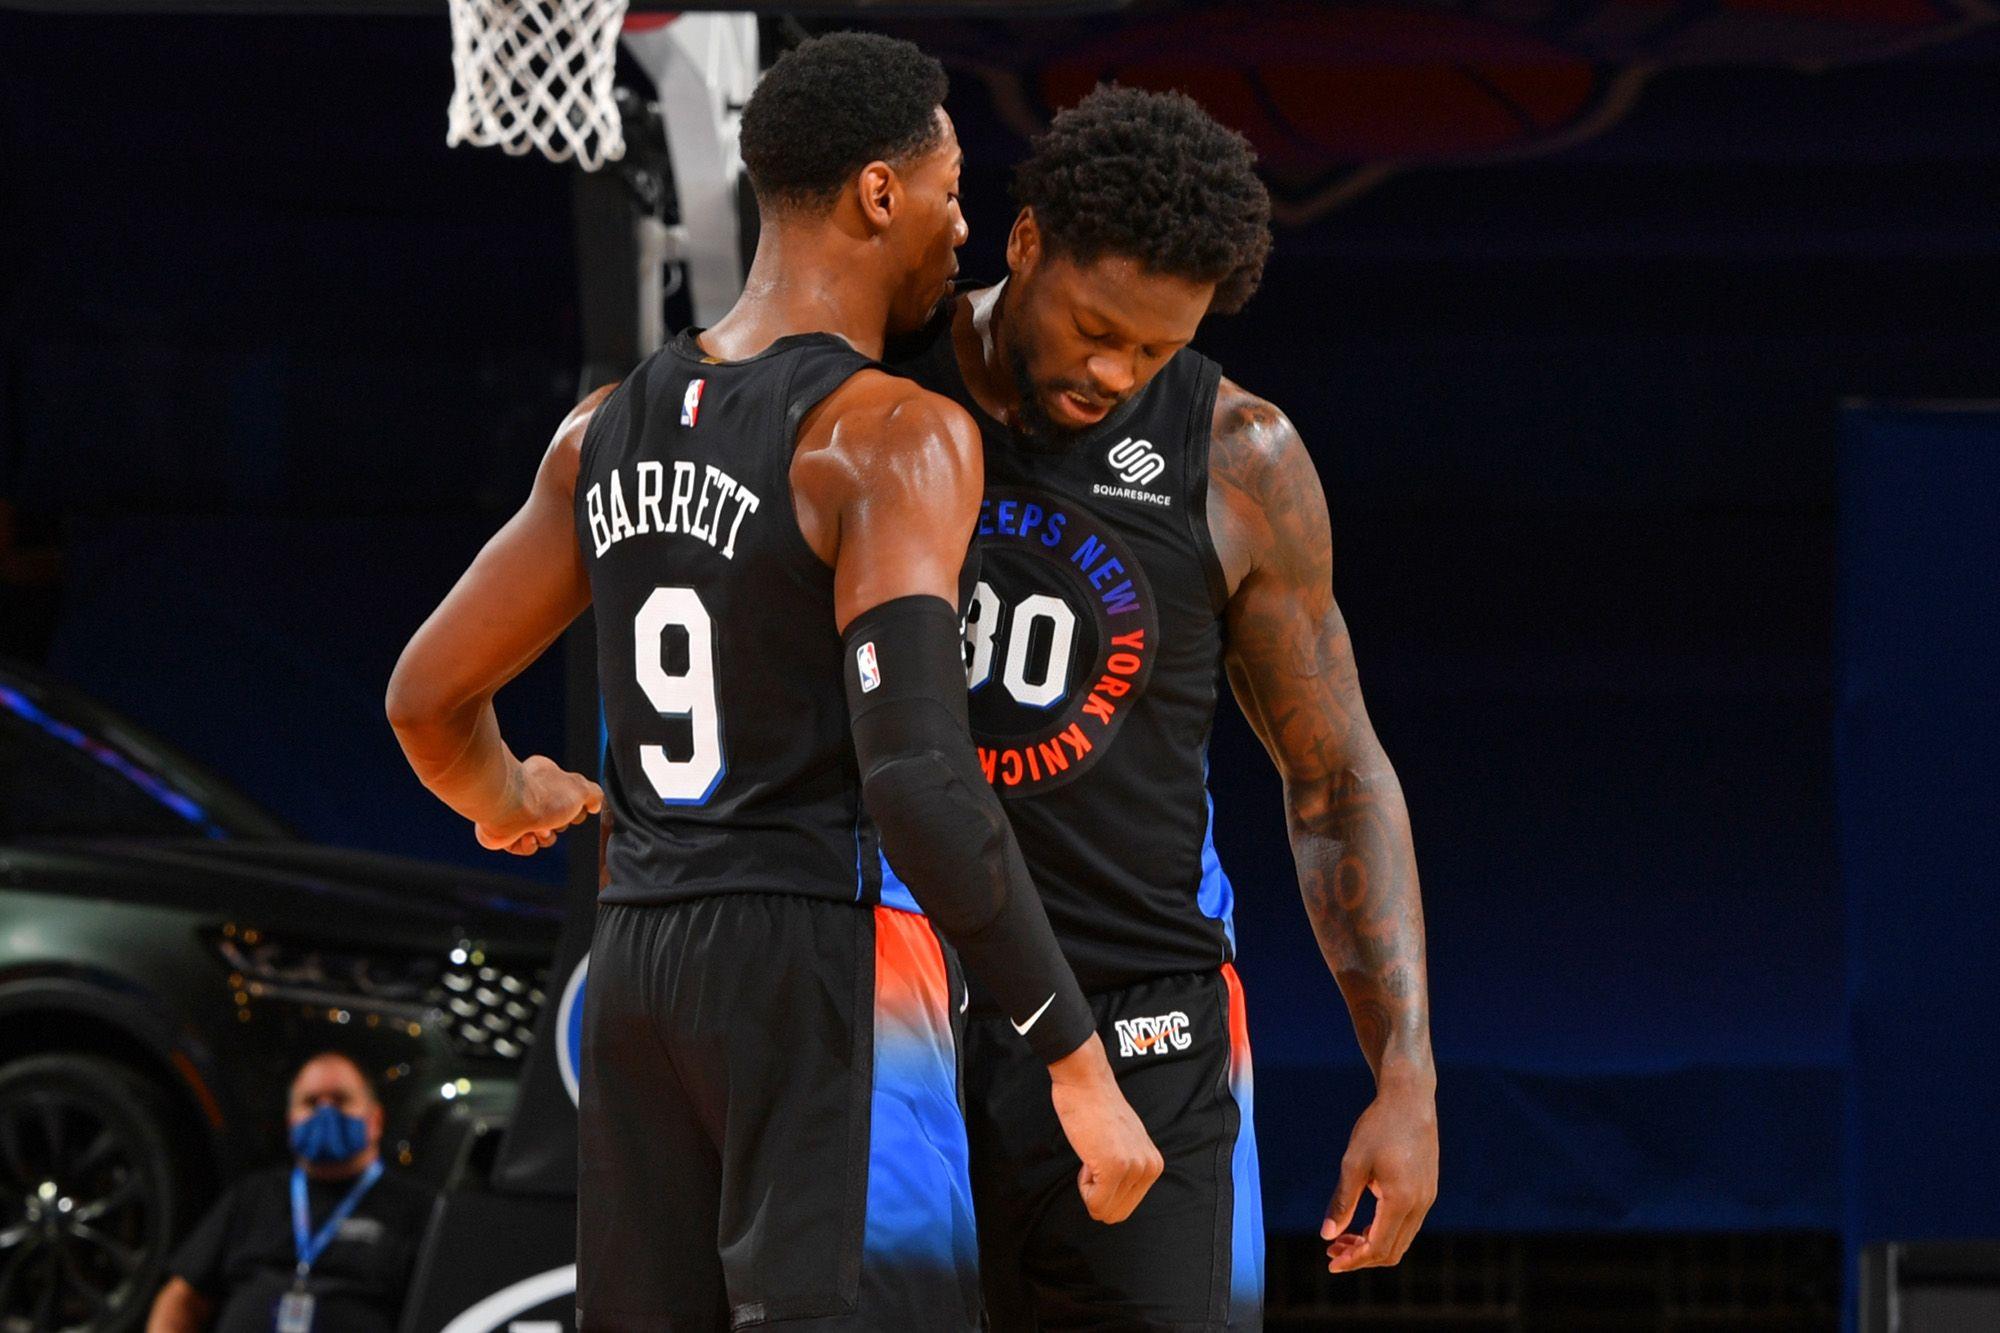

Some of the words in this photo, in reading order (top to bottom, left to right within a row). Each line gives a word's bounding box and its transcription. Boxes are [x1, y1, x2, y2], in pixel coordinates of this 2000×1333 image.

[586, 460, 760, 559] BARRETT
[1093, 484, 1171, 506] SQUARESPACE
[1070, 534, 1140, 615] NEW
[634, 586, 727, 806] 9
[1082, 628, 1145, 725] YORK
[977, 722, 1093, 786] KNICK
[1114, 1011, 1192, 1057] NYC
